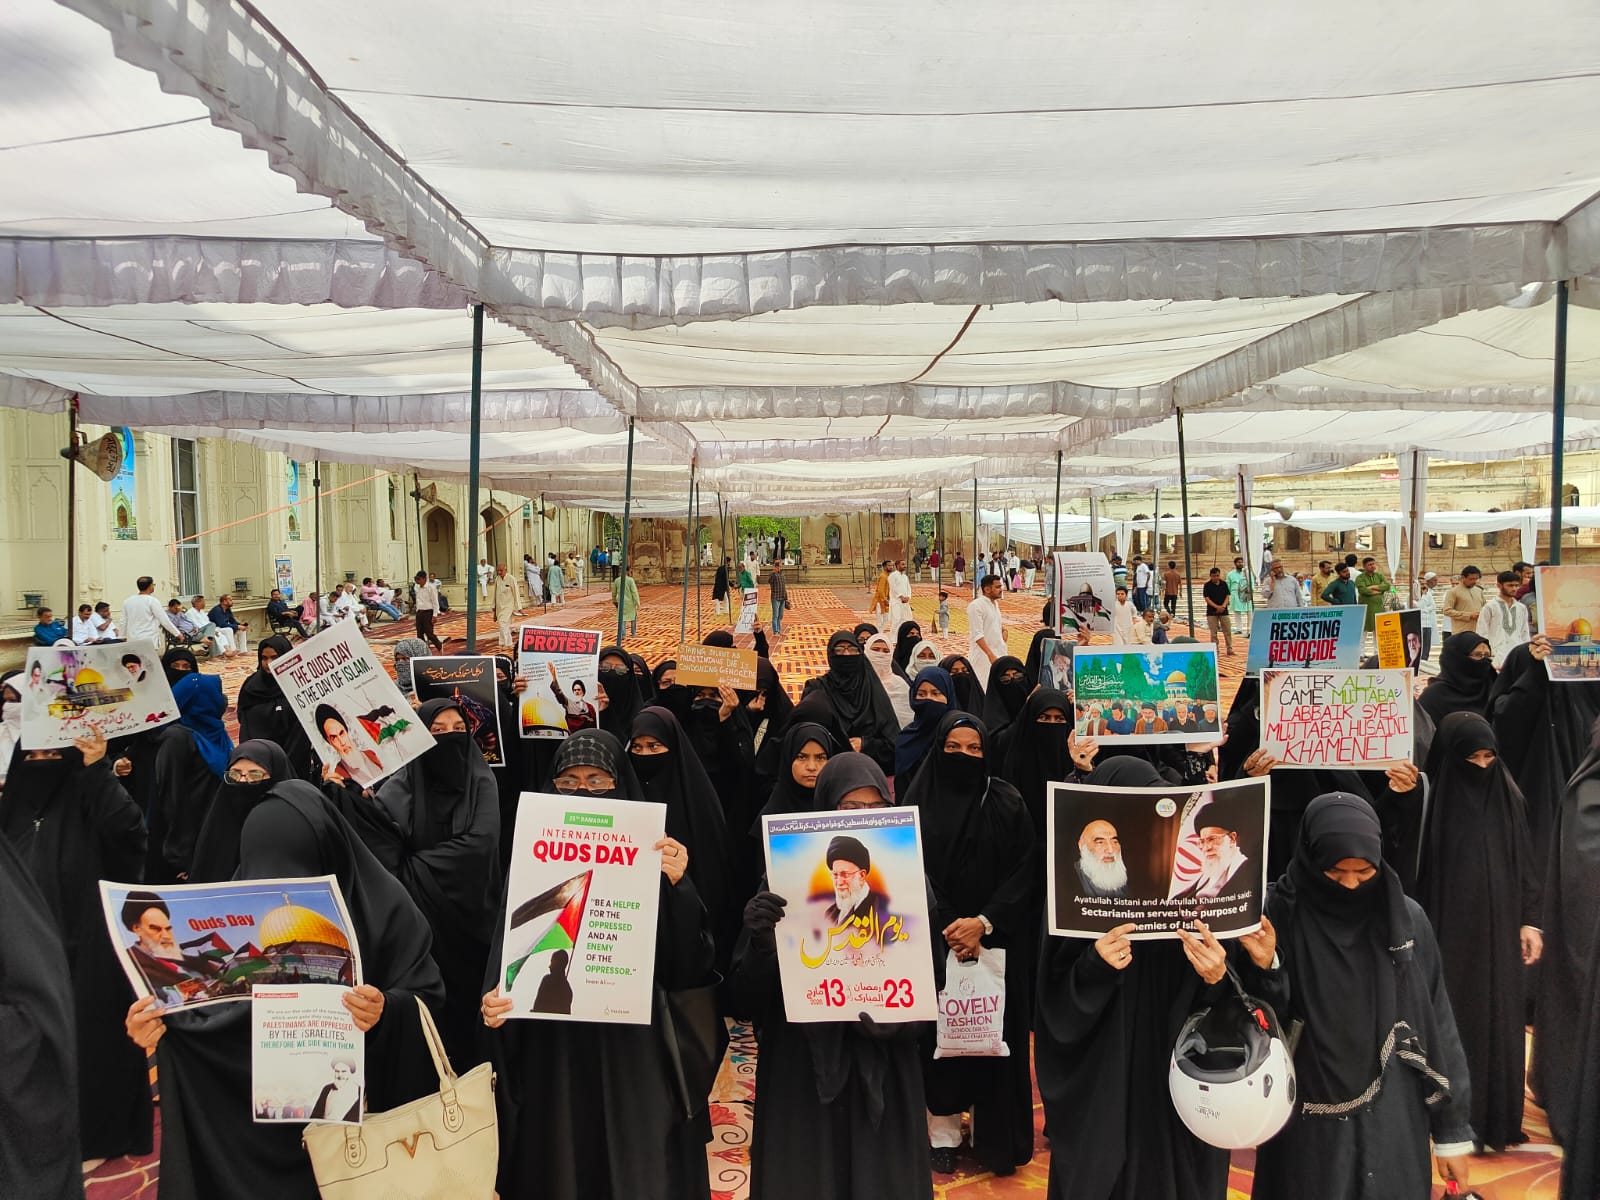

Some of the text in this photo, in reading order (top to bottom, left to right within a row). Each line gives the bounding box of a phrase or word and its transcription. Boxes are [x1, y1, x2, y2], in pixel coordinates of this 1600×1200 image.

[1270, 620, 1341, 641] RESISTING
[523, 635, 596, 653] PROTEST
[1269, 638, 1339, 662] GENOCIDE
[290, 666, 311, 688] THE
[307, 652, 335, 679] QUDS
[330, 640, 353, 666] DAY
[294, 694, 306, 710] IS
[302, 689, 320, 705] THE
[316, 678, 334, 698] DAY
[330, 671, 344, 688] OF
[342, 657, 373, 682] ISLAM.
[1281, 675, 1336, 689] AFTER
[1342, 675, 1377, 690] ALI
[1279, 688, 1324, 705] CAME
[1331, 688, 1395, 704] MUJTABA
[1280, 702, 1399, 722] LABBAIK SYED
[1265, 716, 1408, 742] MUJTABA HUSAINI
[1282, 735, 1393, 763] KHAMENEI
[541, 827, 633, 843] INTERNATIONAL
[533, 839, 639, 866] QUDS DAY
[606, 899, 612, 908] A
[612, 899, 641, 910] HELPER
[1073, 890, 1252, 908] Ayatullah Sistani and Ayatullah Khamenei said:
[589, 909, 621, 919] FOR THE
[1081, 903, 1248, 919] Sectarianism serves the purpose of
[188, 914, 255, 931] Quds Day
[588, 920, 633, 932] OPPRESSED
[1169, 921, 1181, 930] of
[588, 932, 618, 942] AND AN
[586, 942, 614, 952] ENEMY
[586, 953, 612, 963] OF THE
[819, 978, 846, 1007] 13
[883, 978, 915, 1008] 23
[263, 1020, 353, 1031] PALESTINIANS ARE OPPRESSED
[946, 1015, 993, 1027] FASHION
[269, 1030, 279, 1039] BY
[283, 1030, 297, 1039] THE
[261, 1040, 294, 1049] THEREFORE
[297, 1040, 305, 1048] WE
[308, 1039, 320, 1047] SIDE
[322, 1041, 337, 1049] WITH
